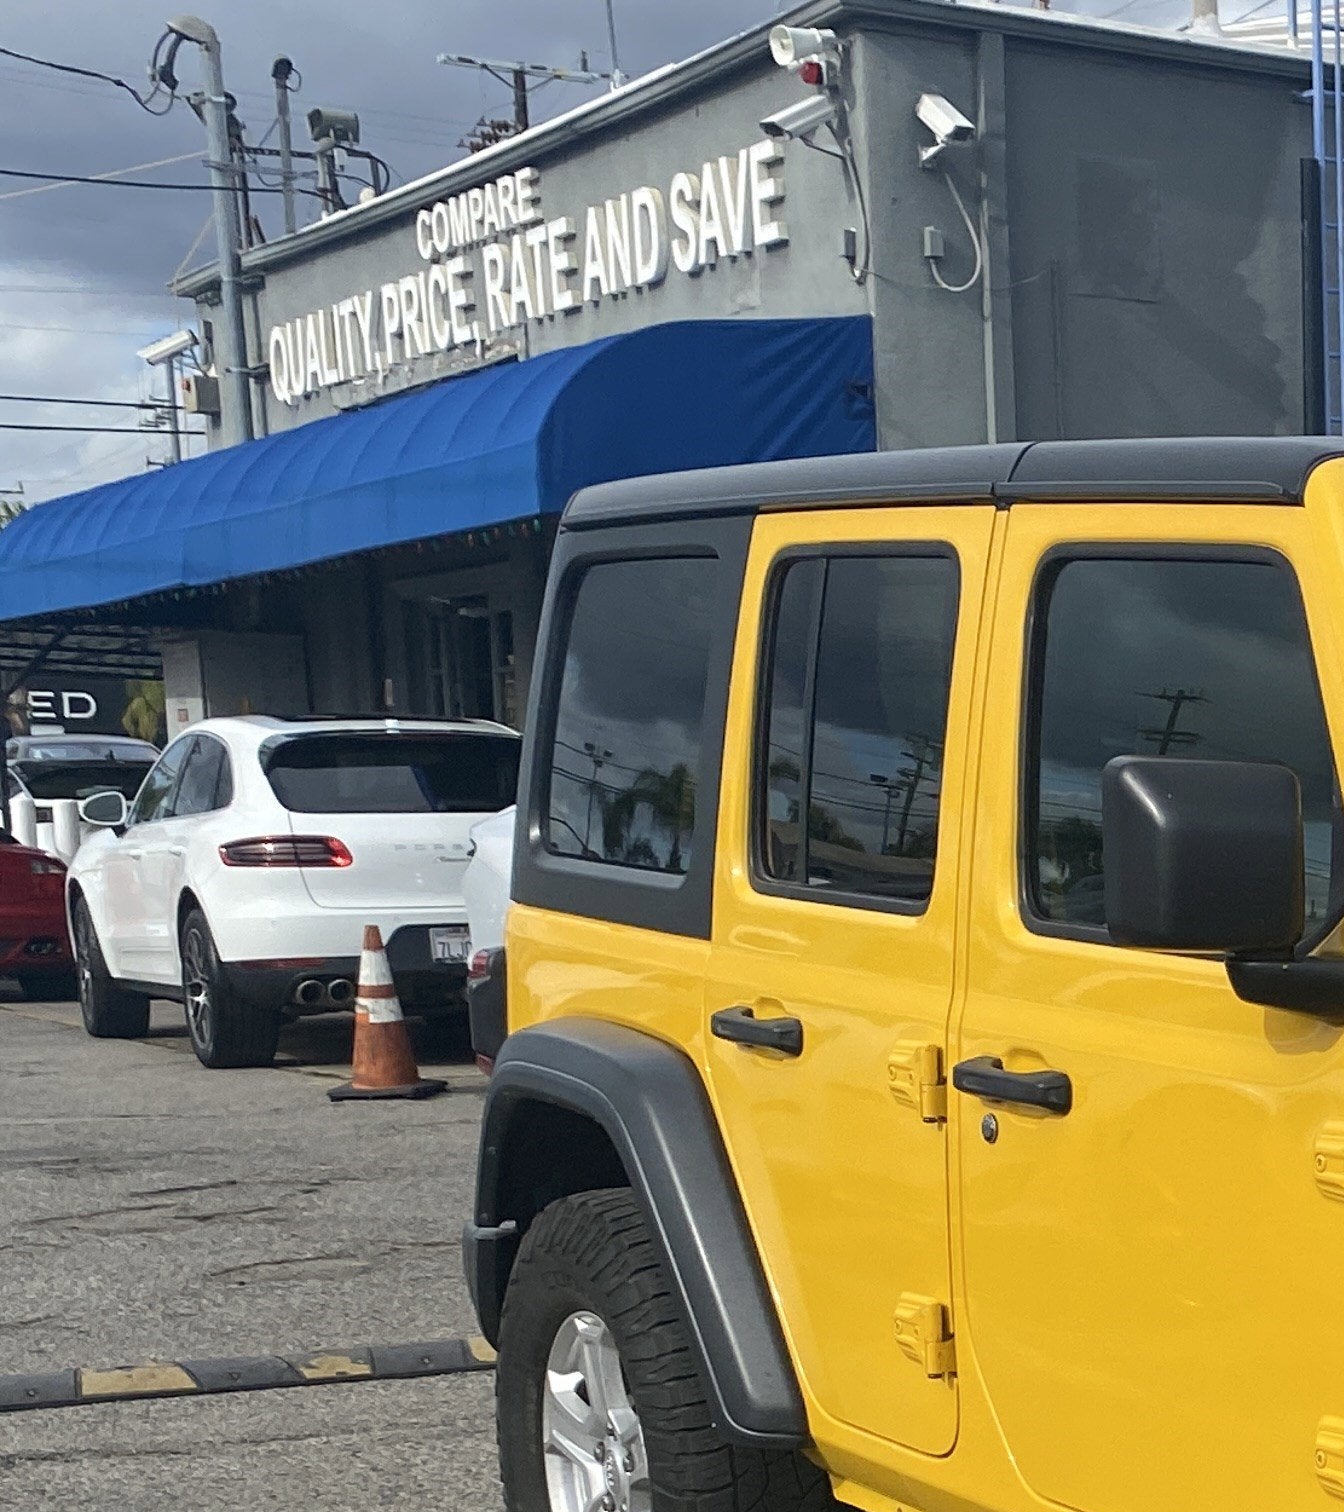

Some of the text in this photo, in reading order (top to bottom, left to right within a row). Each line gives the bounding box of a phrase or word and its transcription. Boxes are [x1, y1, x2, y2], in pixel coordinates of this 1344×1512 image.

[416, 167, 542, 262] COMPARE
[483, 216, 582, 332] RATE
[582, 186, 668, 303] AND
[670, 138, 789, 274] SAVE
